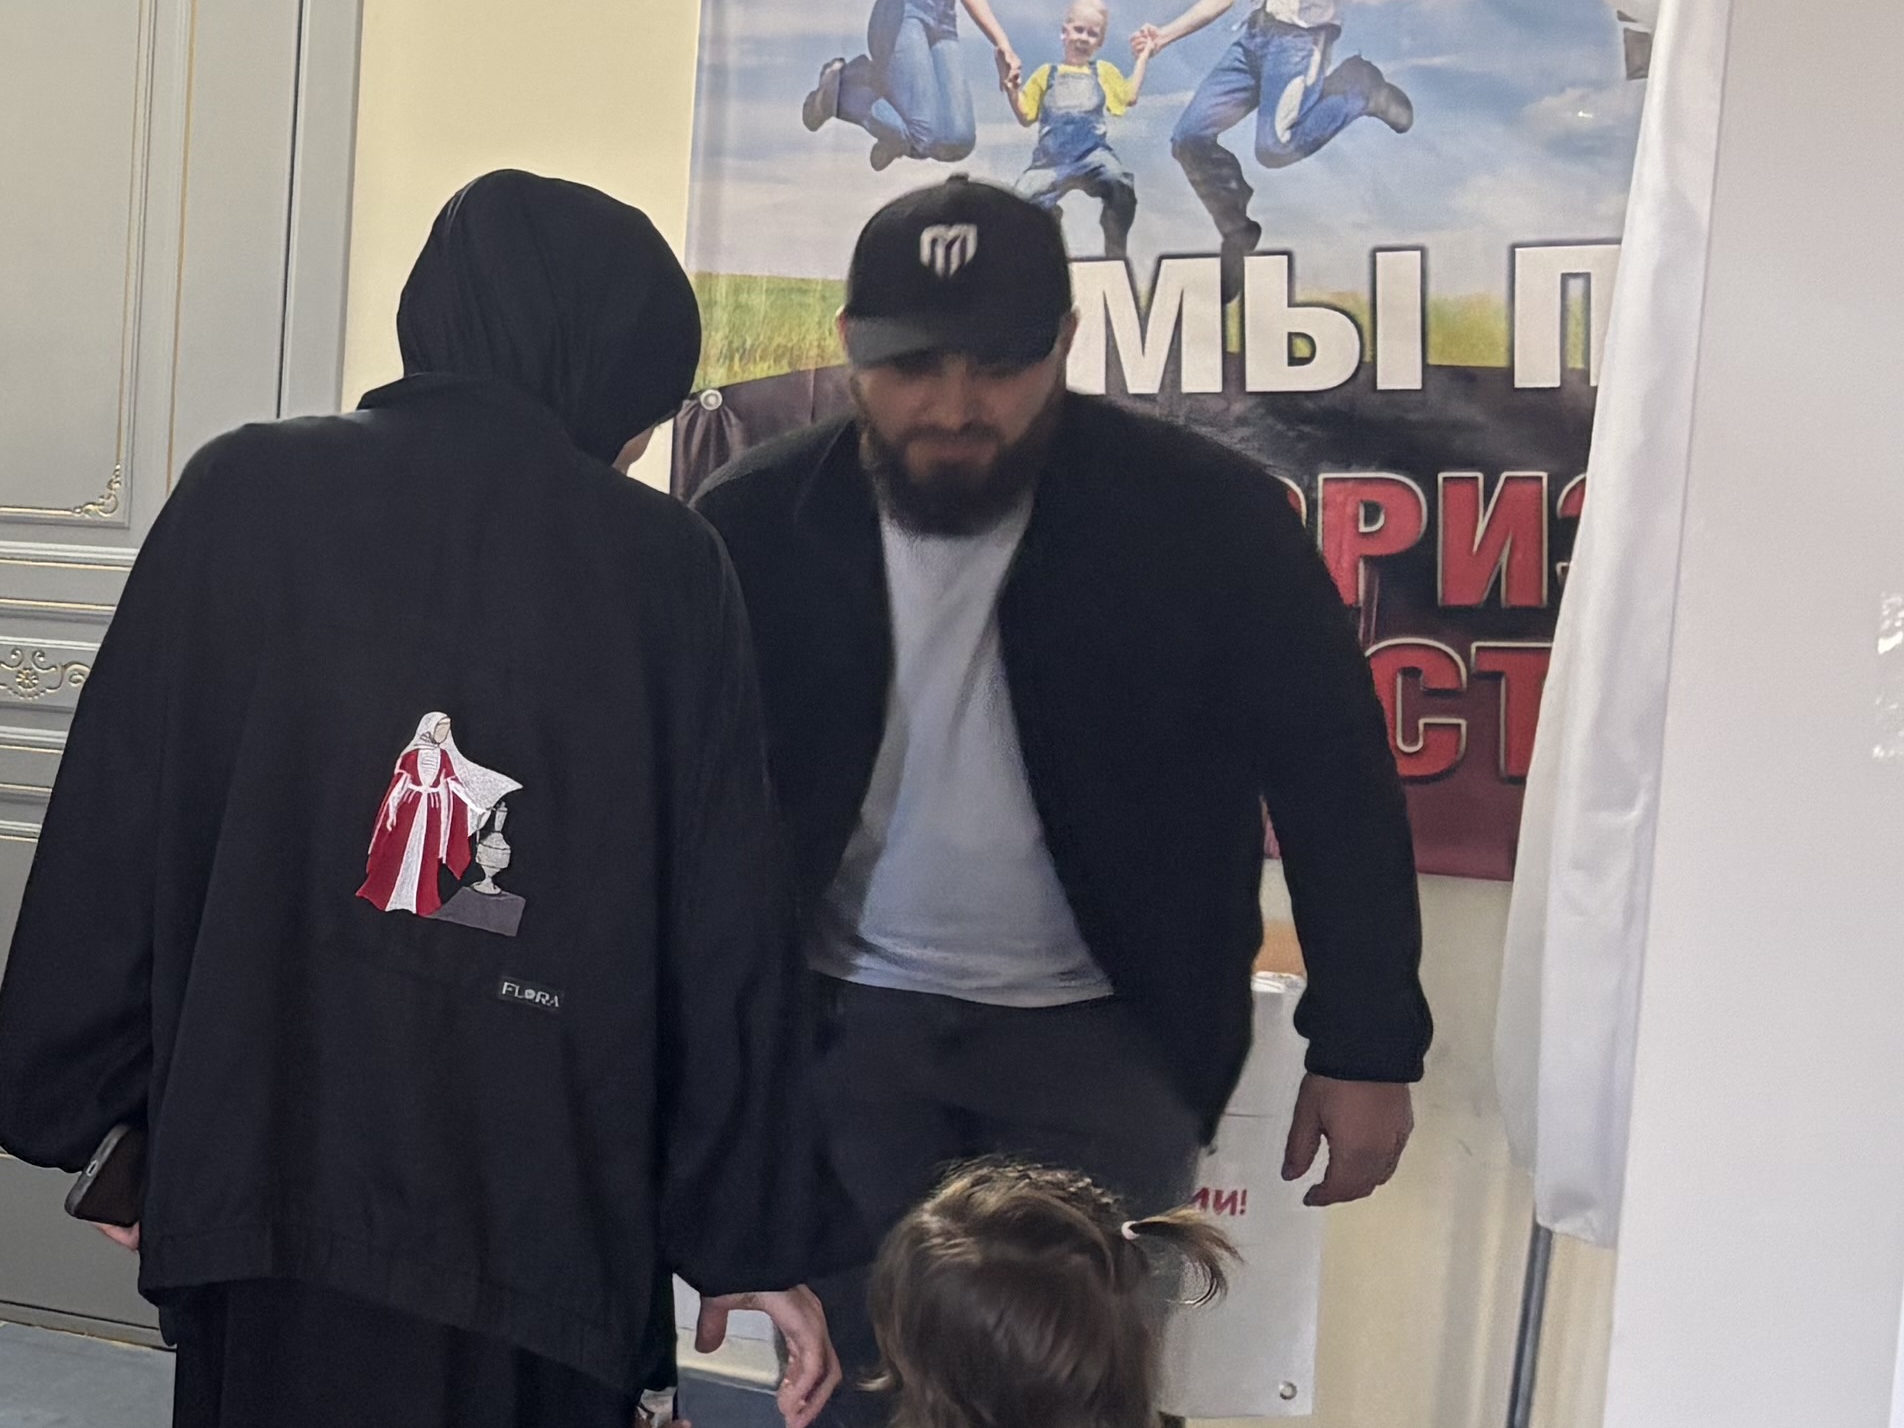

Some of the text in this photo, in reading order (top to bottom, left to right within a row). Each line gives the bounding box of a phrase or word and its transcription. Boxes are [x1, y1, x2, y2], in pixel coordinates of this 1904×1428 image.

[1065, 244, 1623, 395] МЫ П
[1284, 471, 1588, 608] РИ
[1365, 637, 1554, 779] СТ
